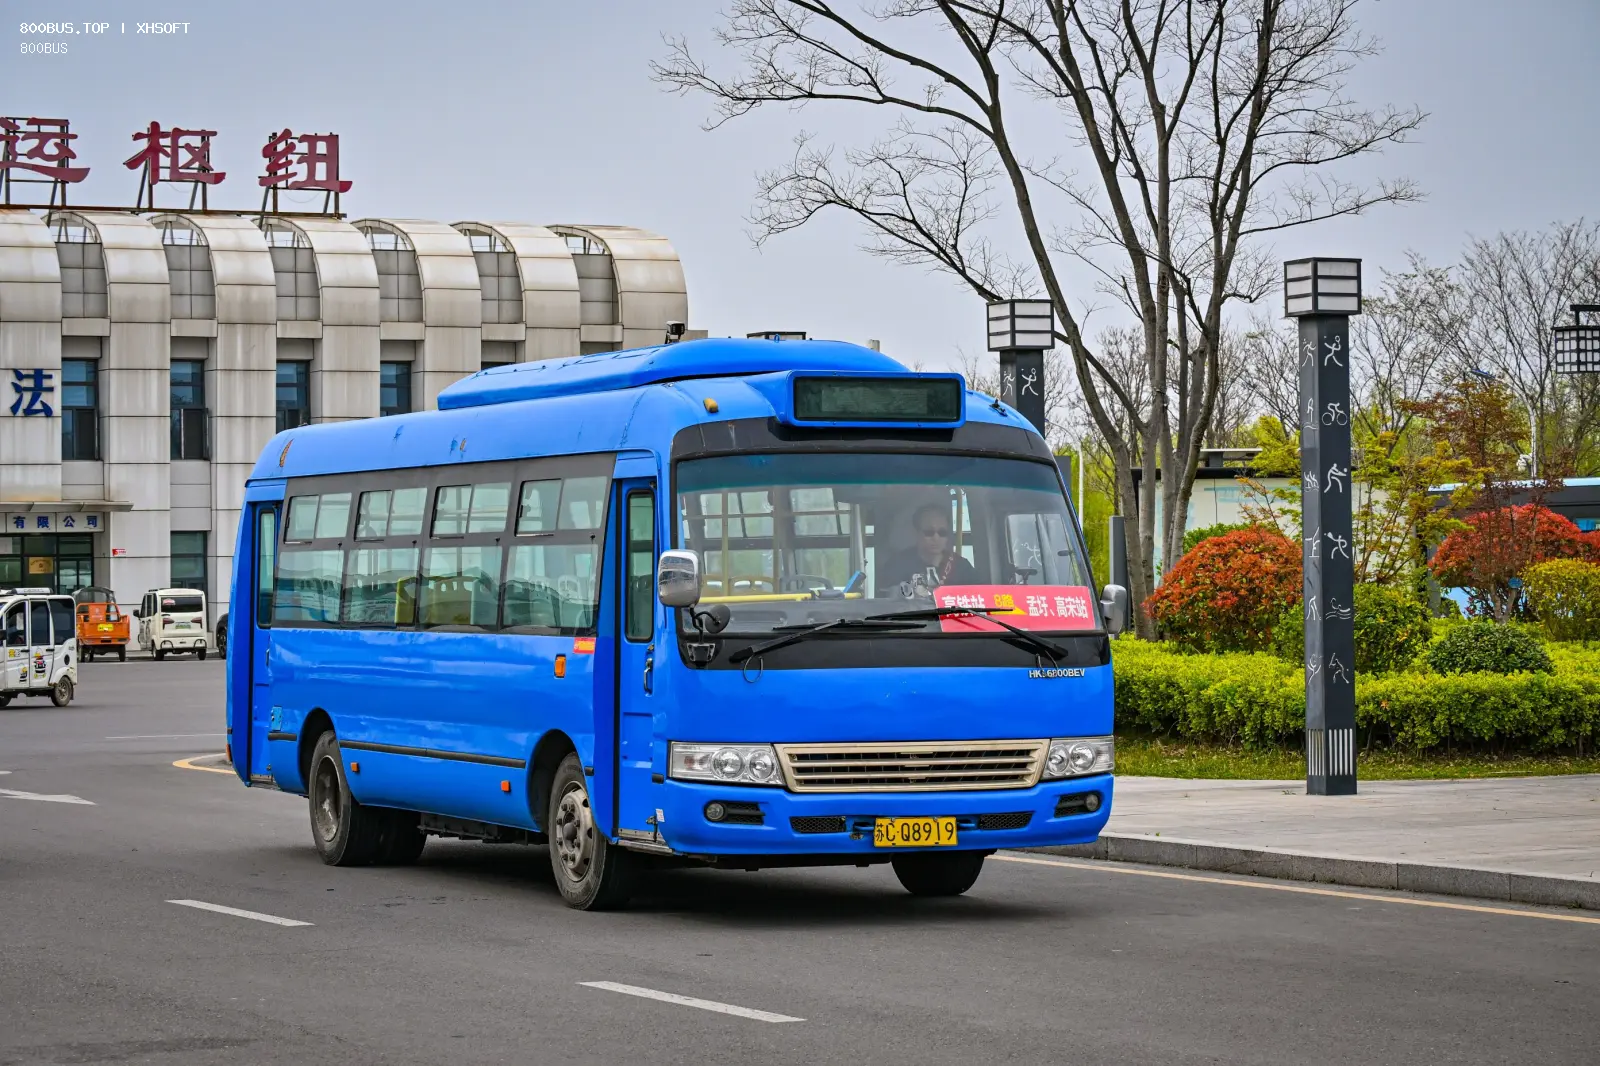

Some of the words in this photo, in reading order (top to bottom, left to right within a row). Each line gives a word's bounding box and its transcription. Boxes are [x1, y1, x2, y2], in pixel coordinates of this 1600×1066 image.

[0, 117, 353, 193] 运枢纽
[10, 368, 55, 418] 法
[13, 515, 98, 529] 有限公司
